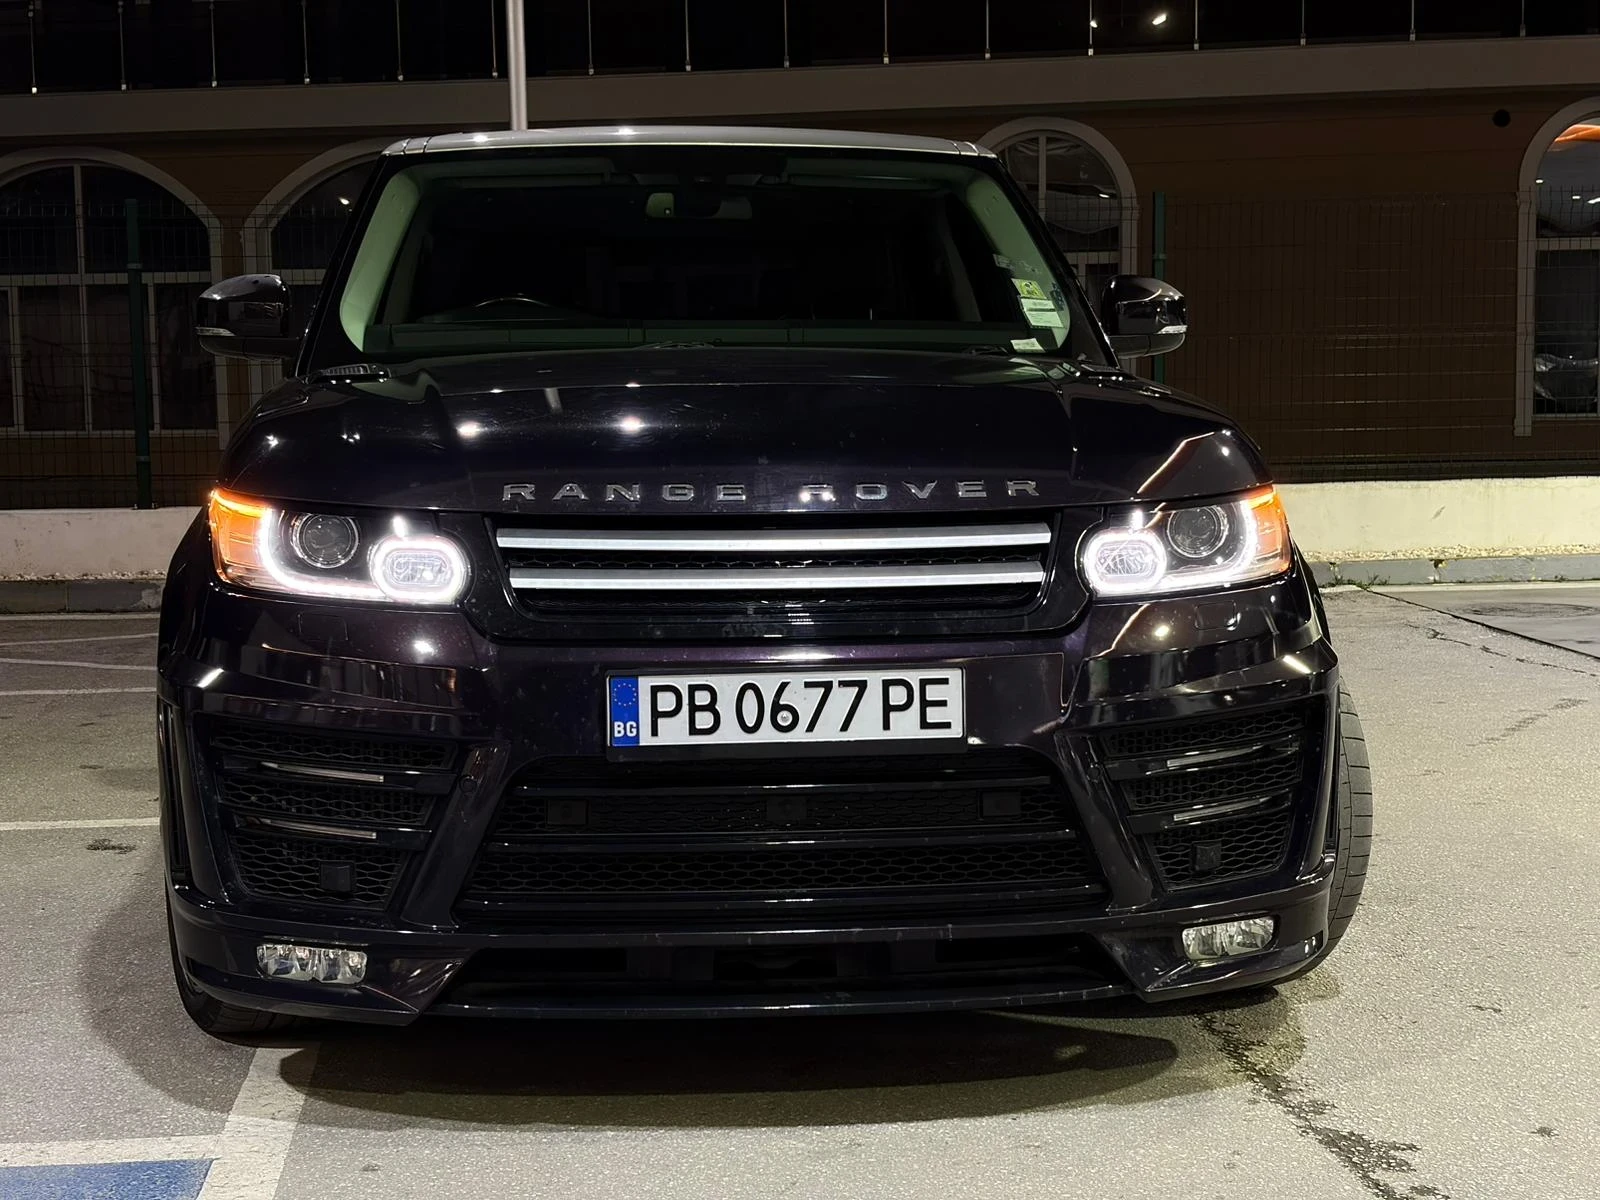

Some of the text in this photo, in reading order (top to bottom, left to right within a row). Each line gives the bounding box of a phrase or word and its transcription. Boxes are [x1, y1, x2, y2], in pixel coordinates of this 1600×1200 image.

[502, 480, 1040, 502] RANGE ROVER
[650, 677, 952, 737] PB 0677 PE
[614, 721, 638, 738] BG
